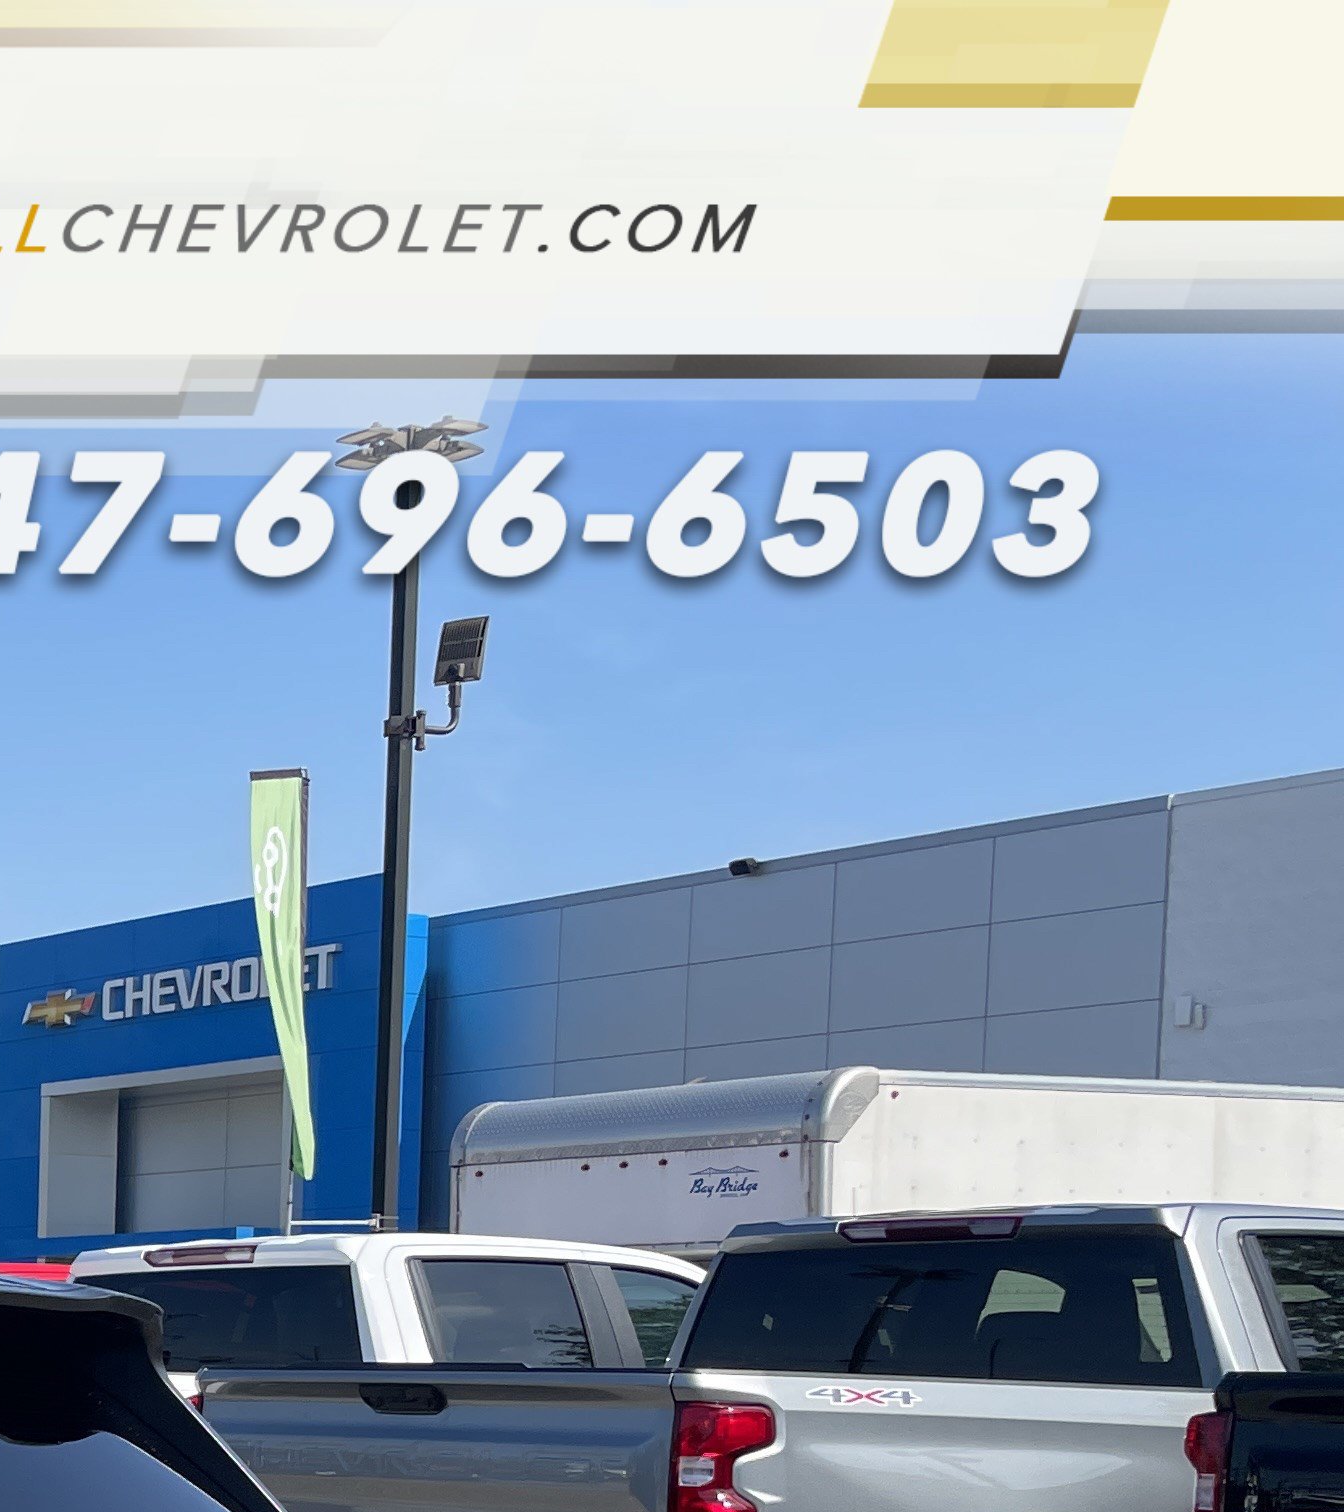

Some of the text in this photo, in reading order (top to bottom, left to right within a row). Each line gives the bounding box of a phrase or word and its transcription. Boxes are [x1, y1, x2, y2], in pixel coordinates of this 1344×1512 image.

[102, 944, 343, 1021] CHEVROT
[689, 1177, 758, 1198] Bay Bridge
